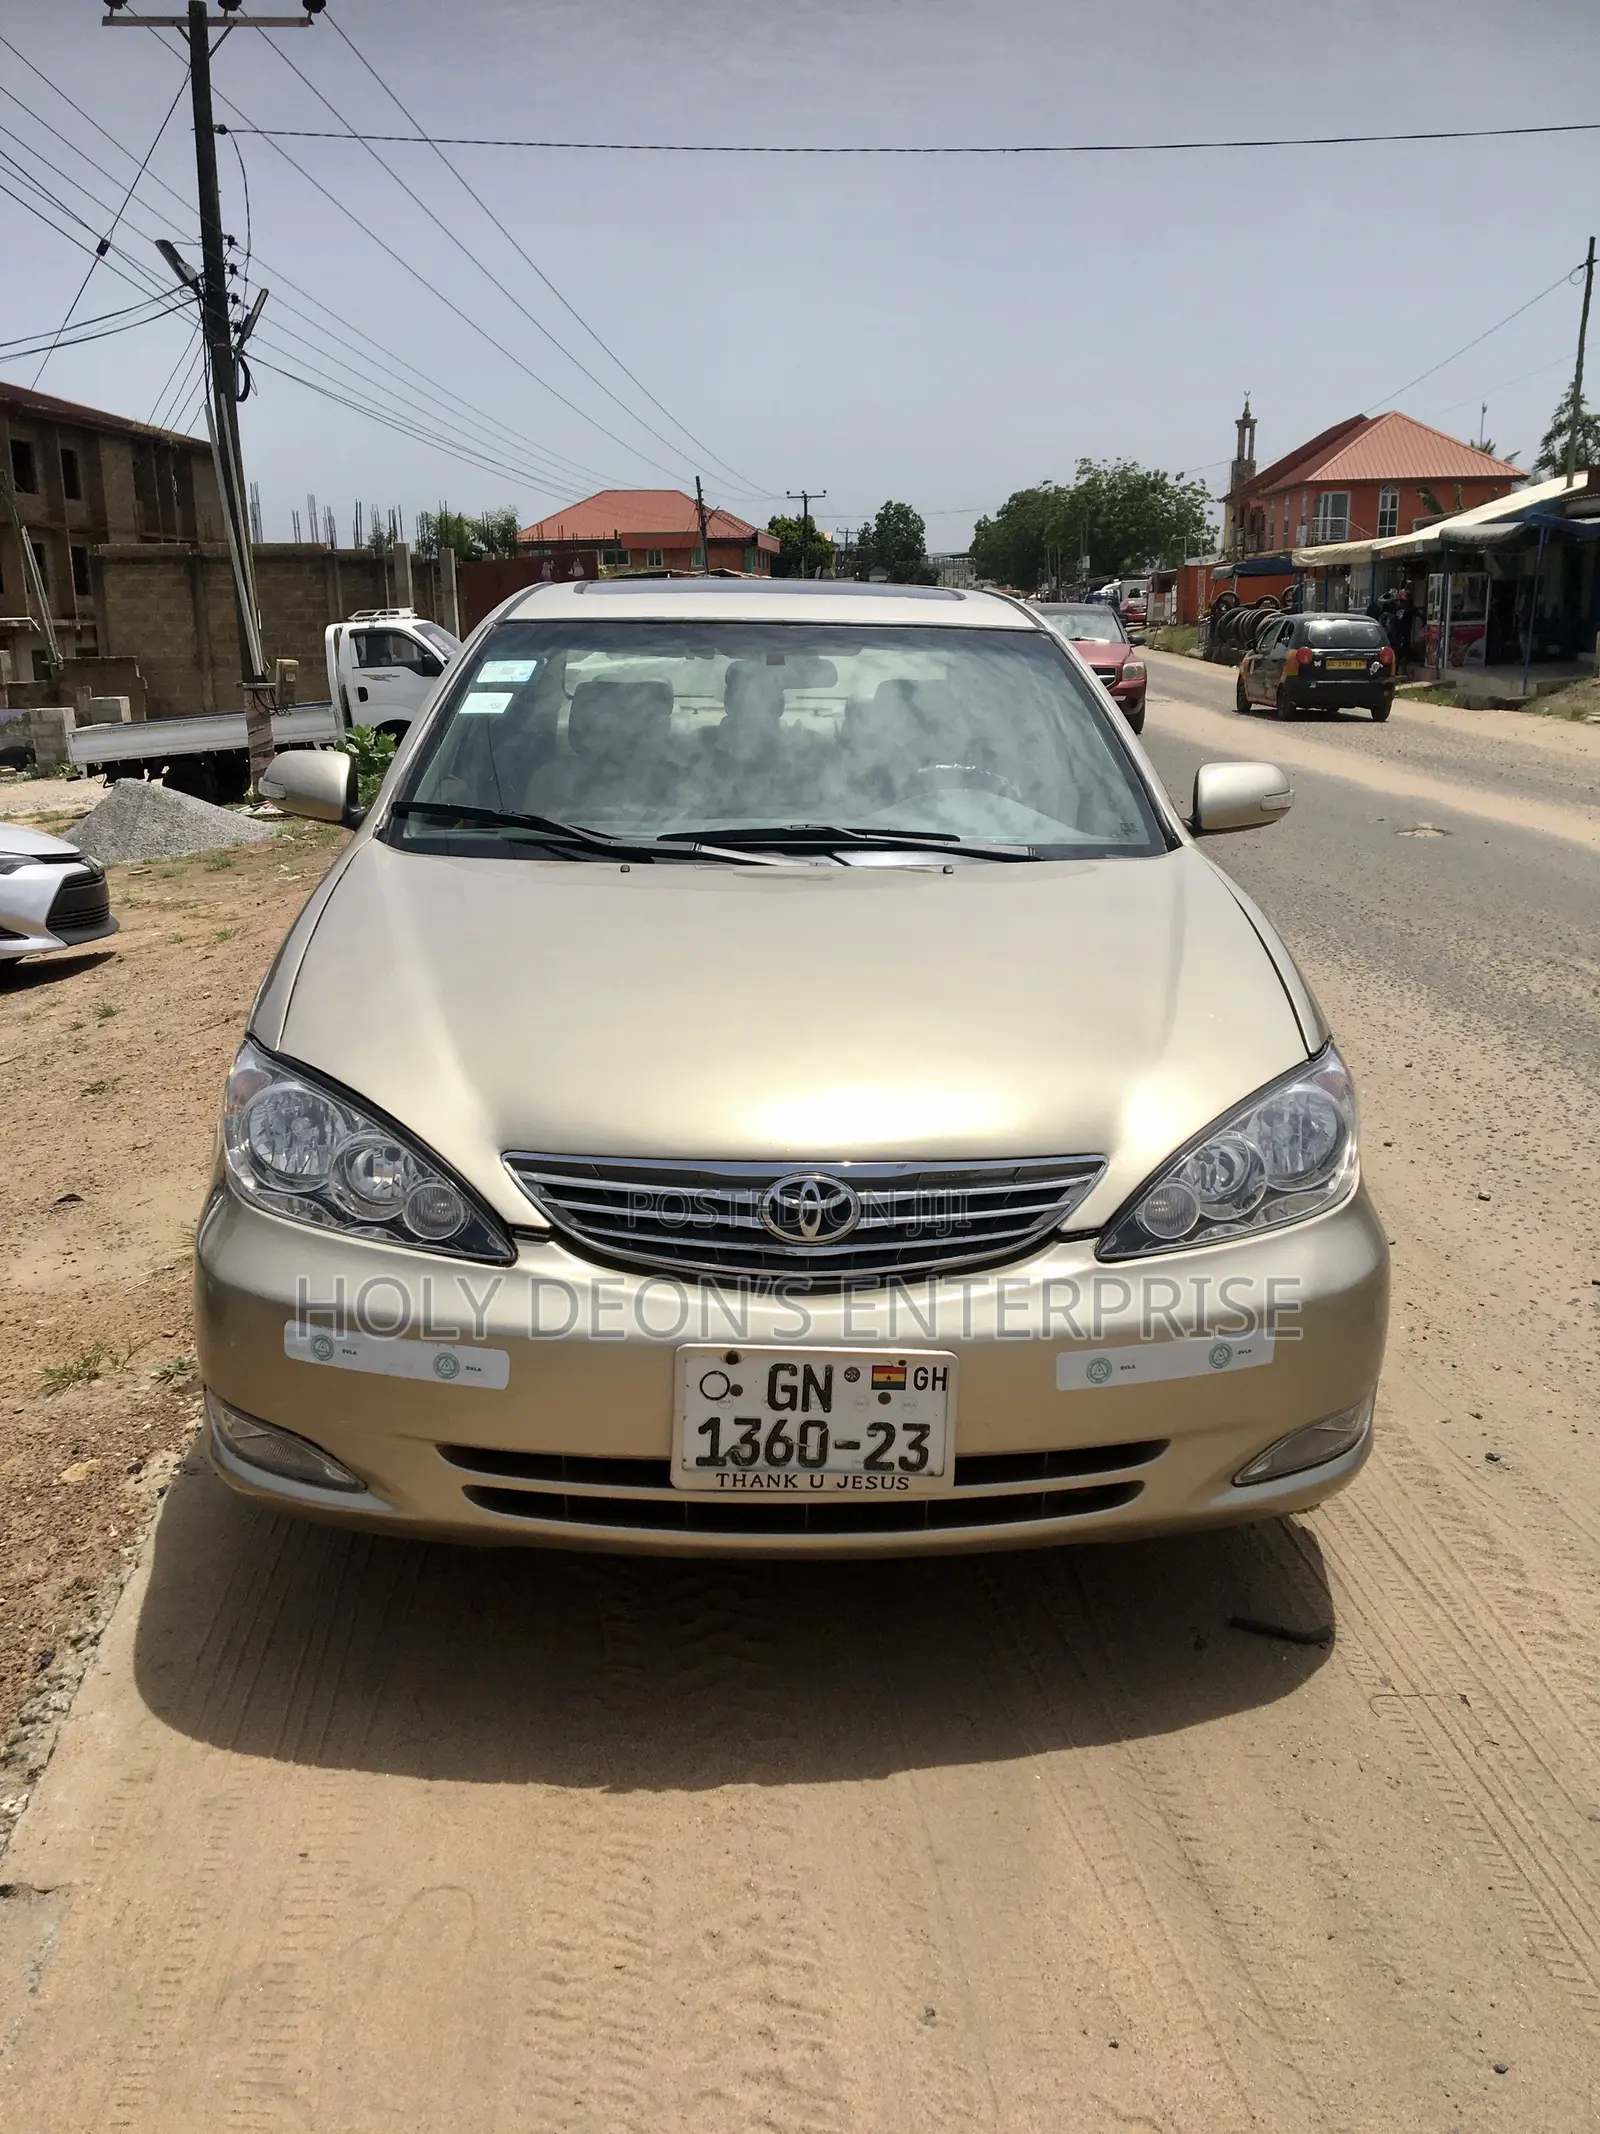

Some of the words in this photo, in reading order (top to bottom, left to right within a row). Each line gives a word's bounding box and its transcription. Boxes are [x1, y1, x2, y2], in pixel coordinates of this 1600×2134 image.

[767, 1363, 834, 1413] GN
[913, 1366, 948, 1391] GH
[695, 1416, 931, 1473] 1360-23
[716, 1473, 798, 1489] THANK
[809, 1474, 825, 1488] U
[836, 1474, 911, 1491] JESUS
